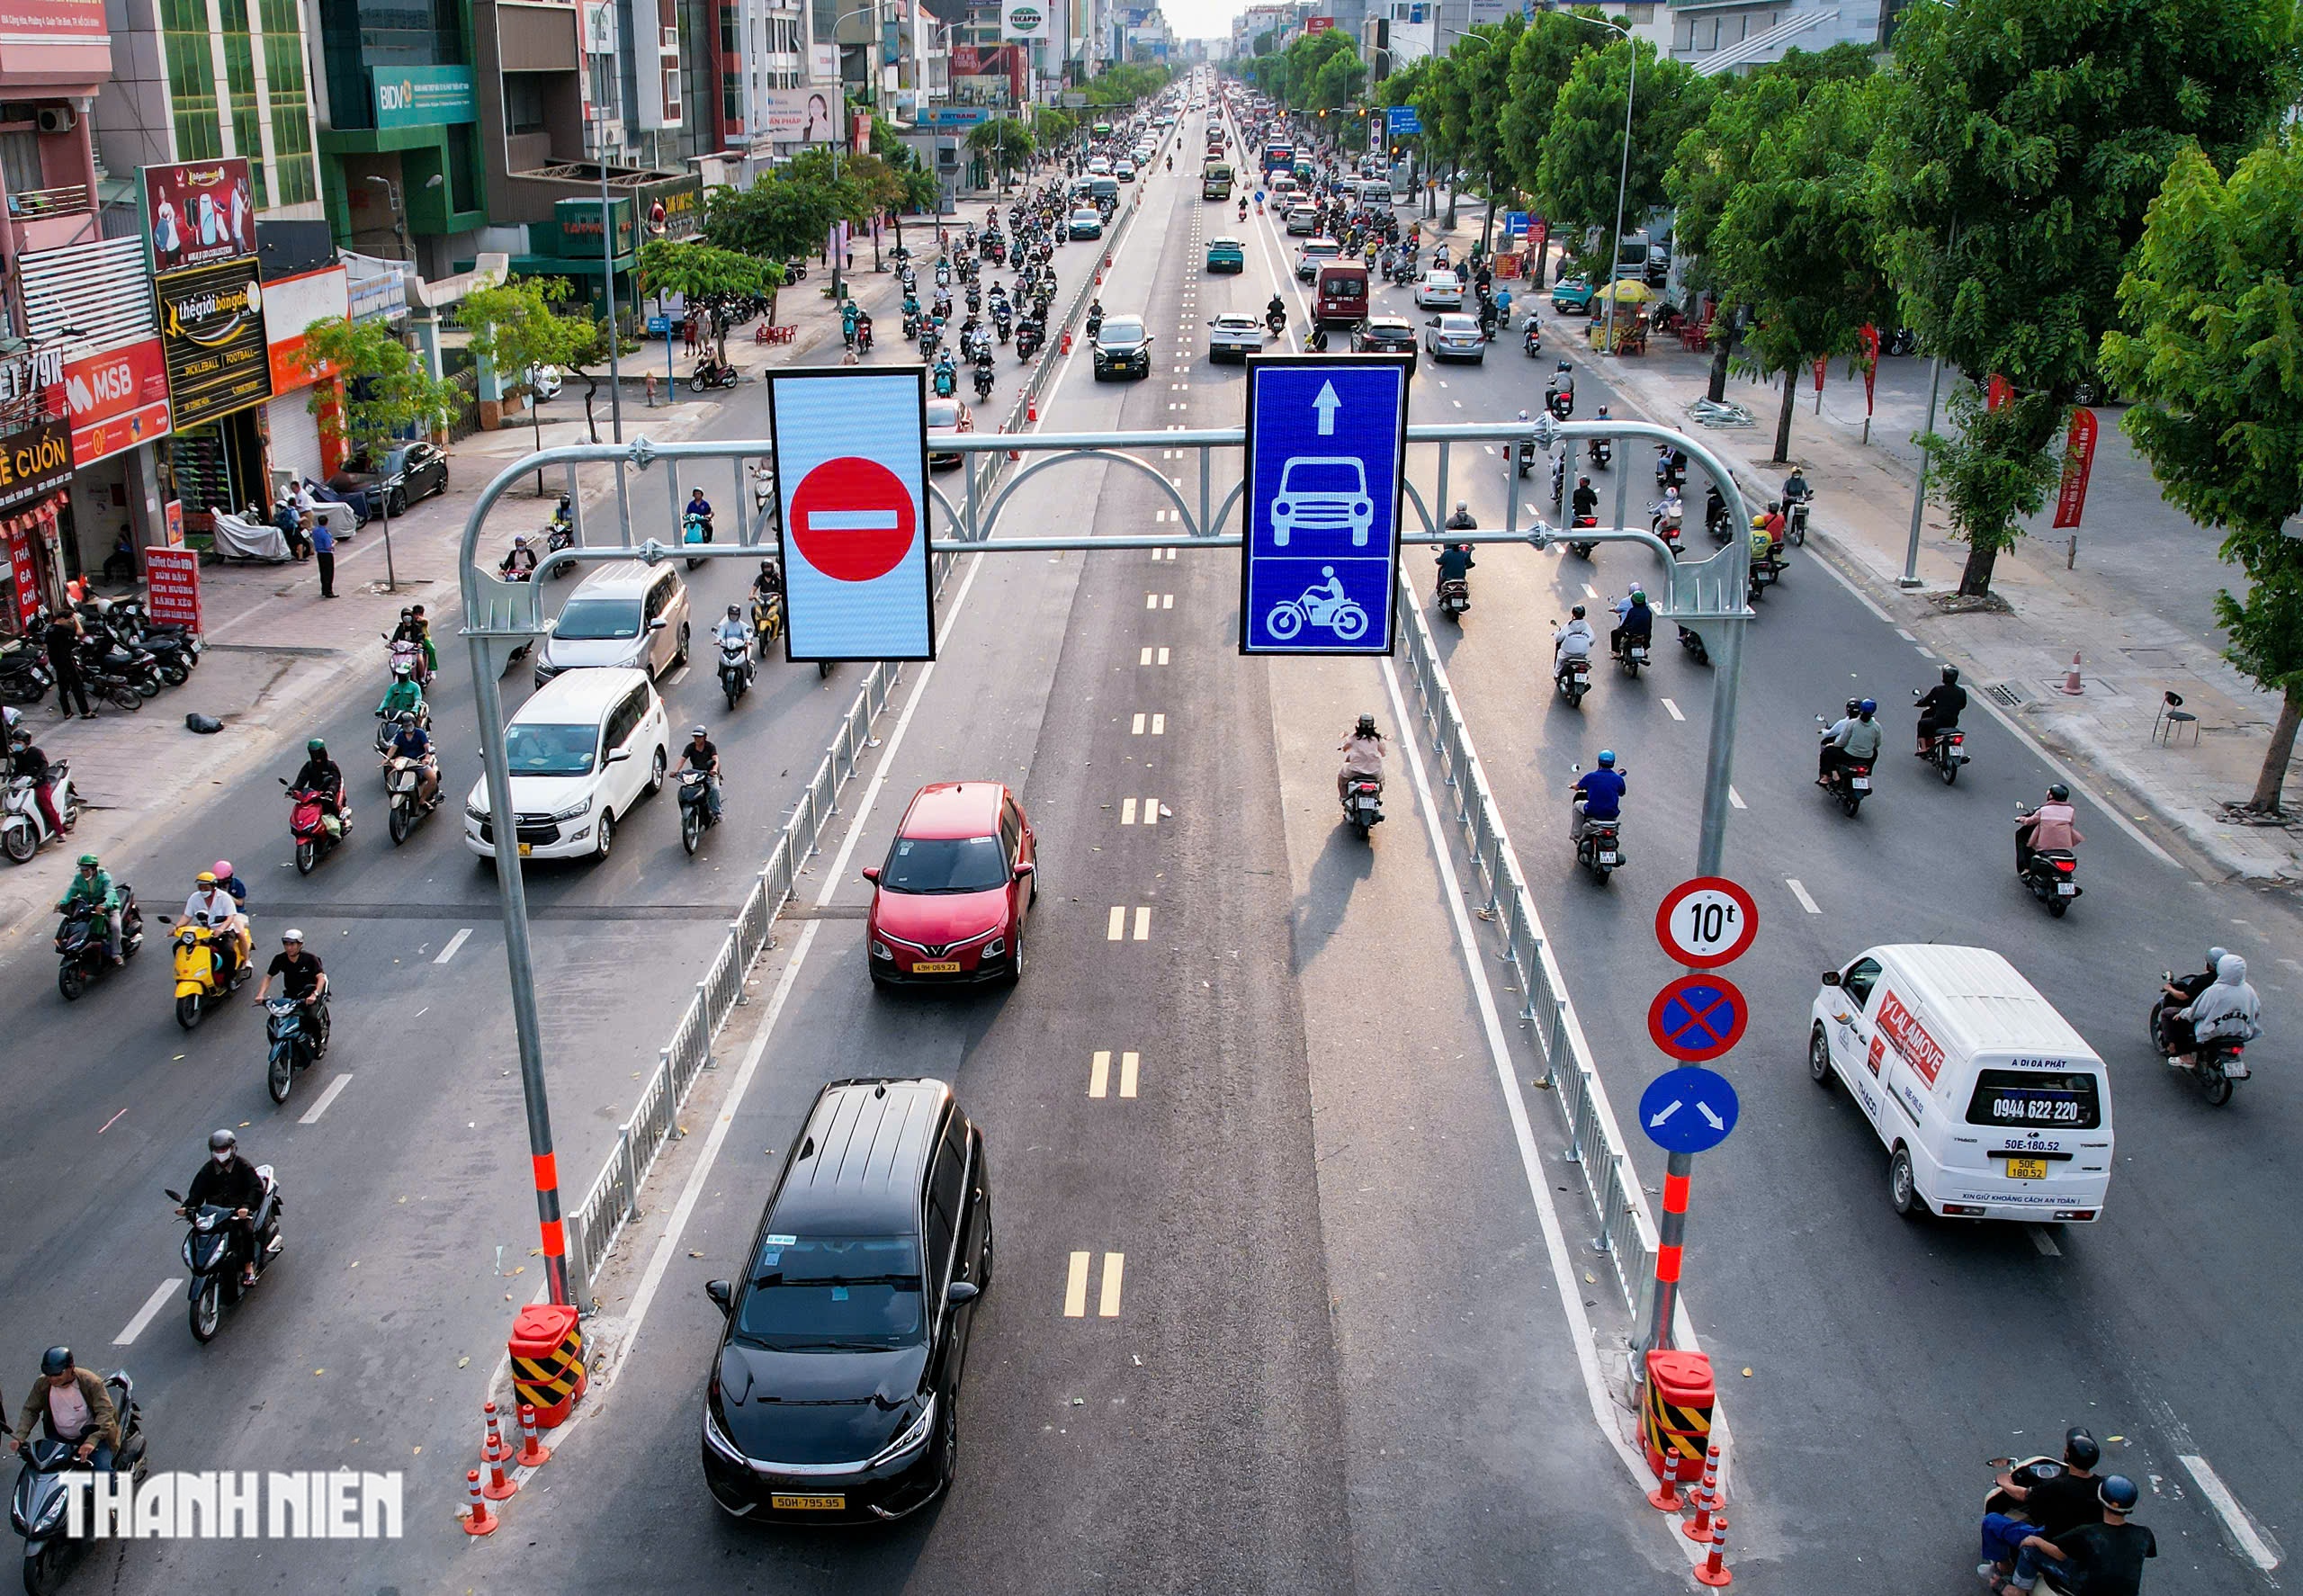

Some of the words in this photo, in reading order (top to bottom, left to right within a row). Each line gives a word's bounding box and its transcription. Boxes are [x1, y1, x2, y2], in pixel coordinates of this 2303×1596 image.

[380, 85, 403, 110] BIDV
[184, 358, 220, 376] PICKLEBALL
[226, 349, 255, 364] FOOTBALL
[93, 363, 132, 404] MSB
[16, 427, 67, 478] CUỐN
[14, 542, 31, 563] THẢ
[20, 569, 31, 583] GA
[1889, 1004, 1944, 1073] LALAMOVE
[2045, 1059, 2067, 1070] PHẬT
[1858, 1080, 1877, 1116] THACO
[1993, 1098, 2025, 1118] 0944
[2028, 1100, 2052, 1119] 622
[2054, 1101, 2078, 1120] 220
[2004, 1140, 2060, 1152] 50E-180.52
[2012, 1169, 2042, 1178] 180.52
[2018, 1160, 2036, 1169] 50E
[2024, 1195, 2043, 1203] CÁCH
[777, 1498, 839, 1508] 50H-795.95
